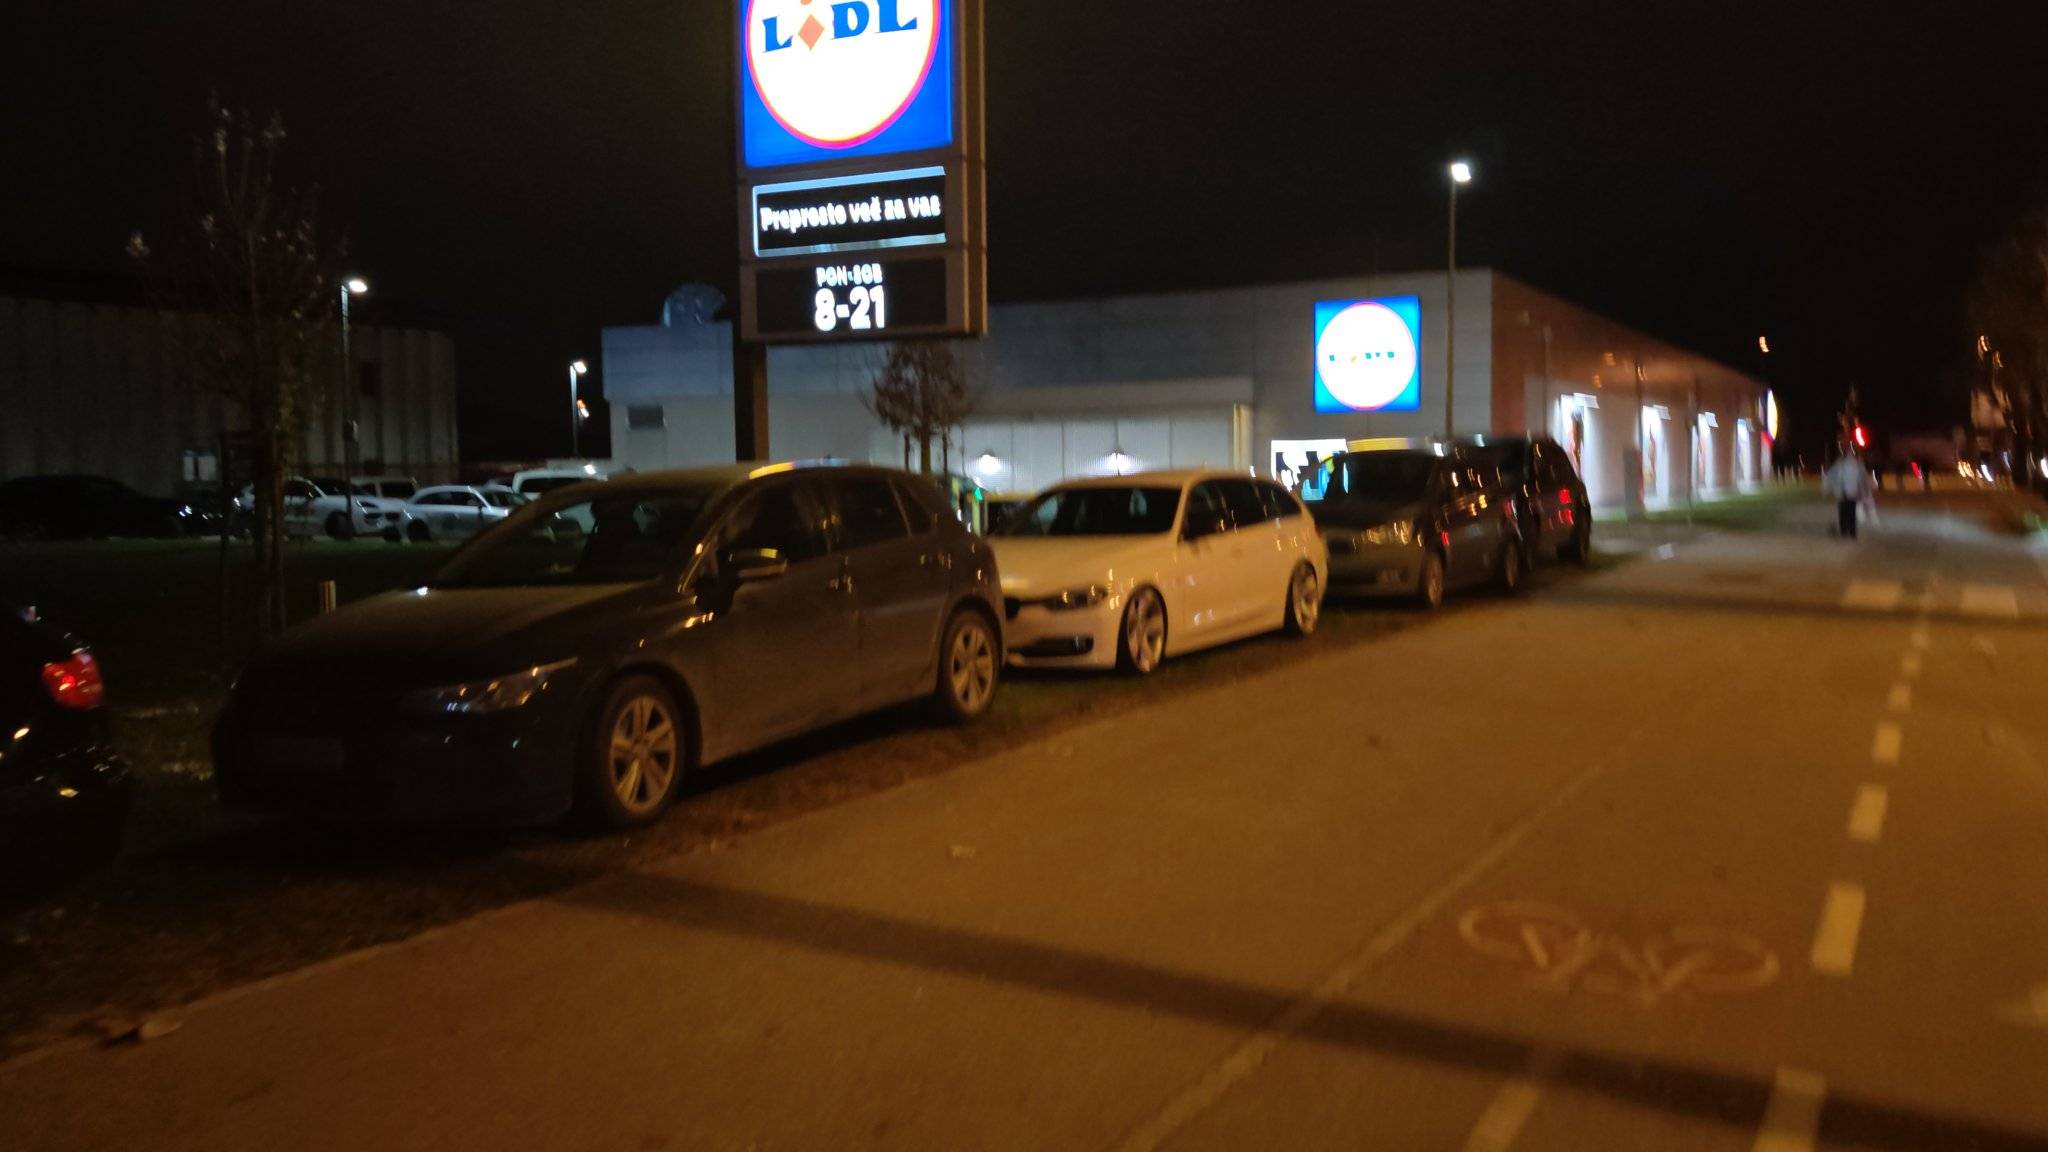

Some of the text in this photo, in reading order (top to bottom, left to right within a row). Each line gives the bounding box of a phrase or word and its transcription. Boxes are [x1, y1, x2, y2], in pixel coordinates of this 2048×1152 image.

[760, 203, 847, 233] Preprosto
[884, 199, 906, 220] za
[908, 195, 941, 218] vas
[816, 263, 883, 287] PON-SOB
[815, 285, 885, 332] 8-21
